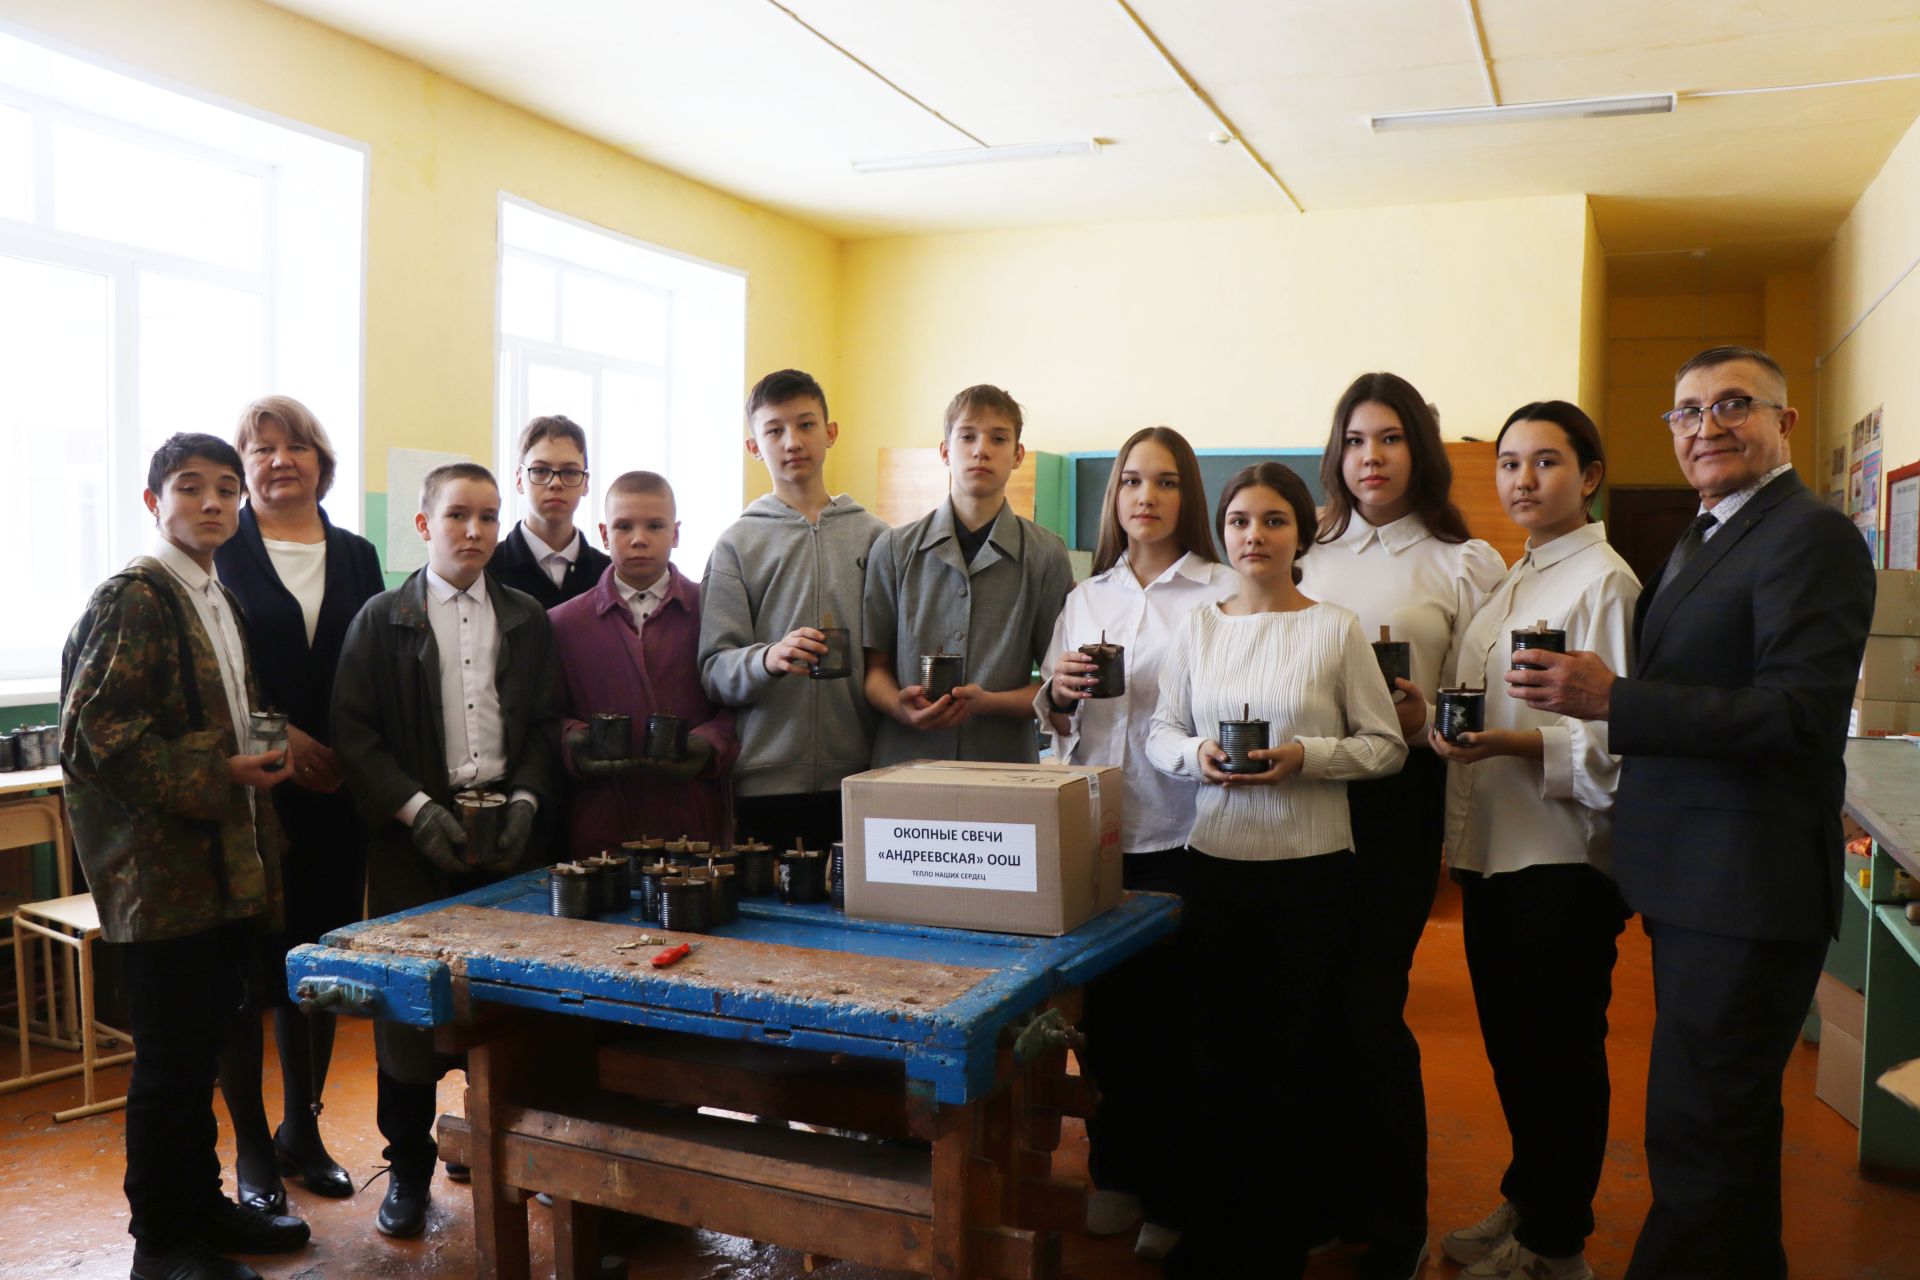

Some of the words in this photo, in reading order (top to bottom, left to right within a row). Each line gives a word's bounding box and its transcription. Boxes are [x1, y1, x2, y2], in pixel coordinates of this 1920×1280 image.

[893, 827, 958, 841] ОКОПНЫЕ
[961, 830, 1003, 843] СВЕЧИ
[878, 849, 984, 864] «АНДРЕЕВСКАЯ»
[987, 854, 1021, 867] ООШ
[912, 870, 934, 878] ТЕПЛО
[960, 873, 987, 881] СЕРДЕЦ
